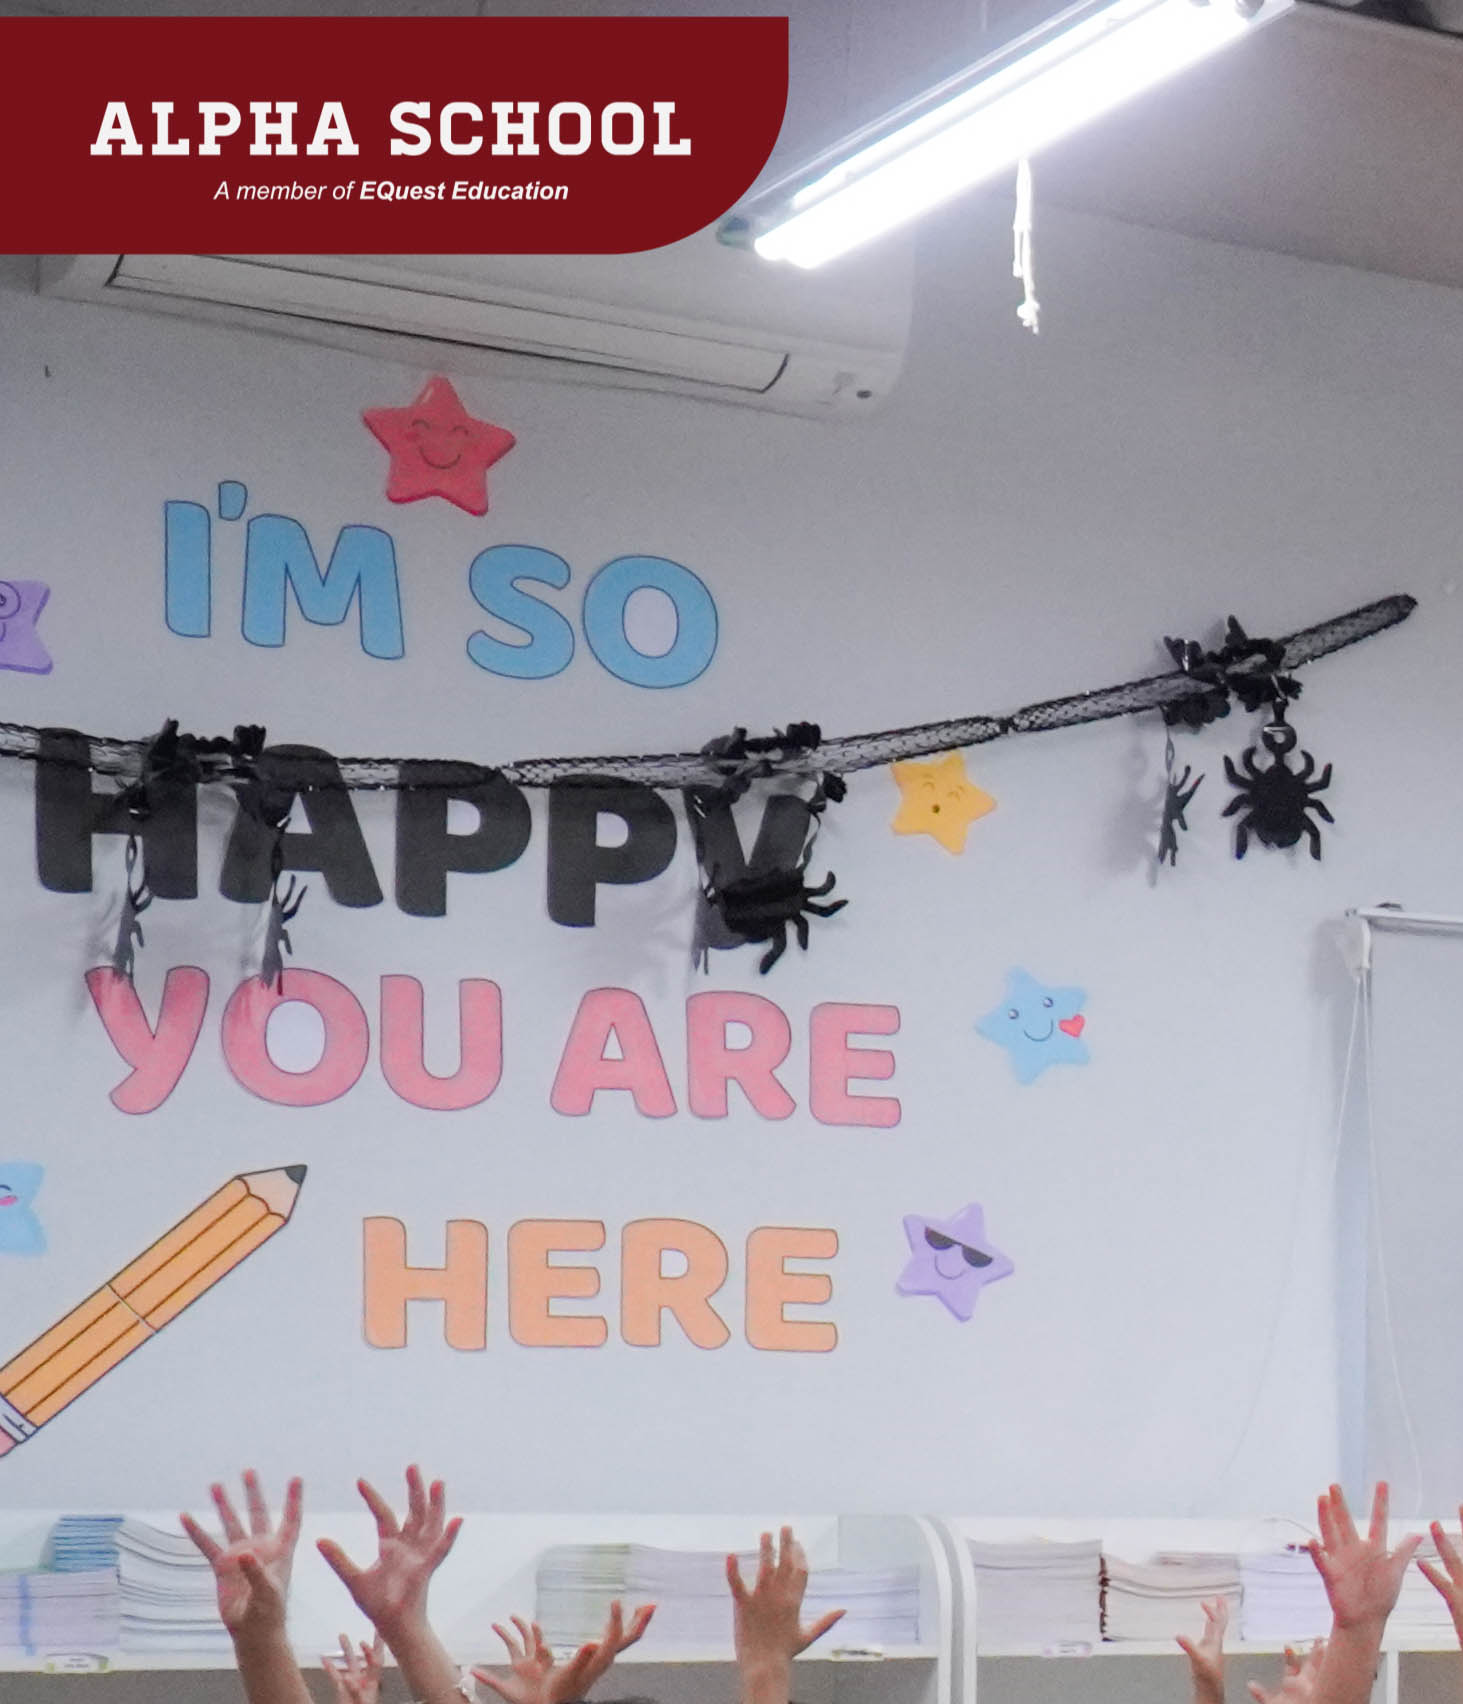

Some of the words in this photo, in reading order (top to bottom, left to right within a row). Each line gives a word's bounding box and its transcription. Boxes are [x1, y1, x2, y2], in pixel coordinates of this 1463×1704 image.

[164, 481, 404, 661] I'M
[466, 544, 718, 689] SO
[35, 727, 812, 950] HAPPY
[86, 965, 504, 1116] YOU
[551, 988, 902, 1128] ARE
[363, 1217, 839, 1353] HERE
